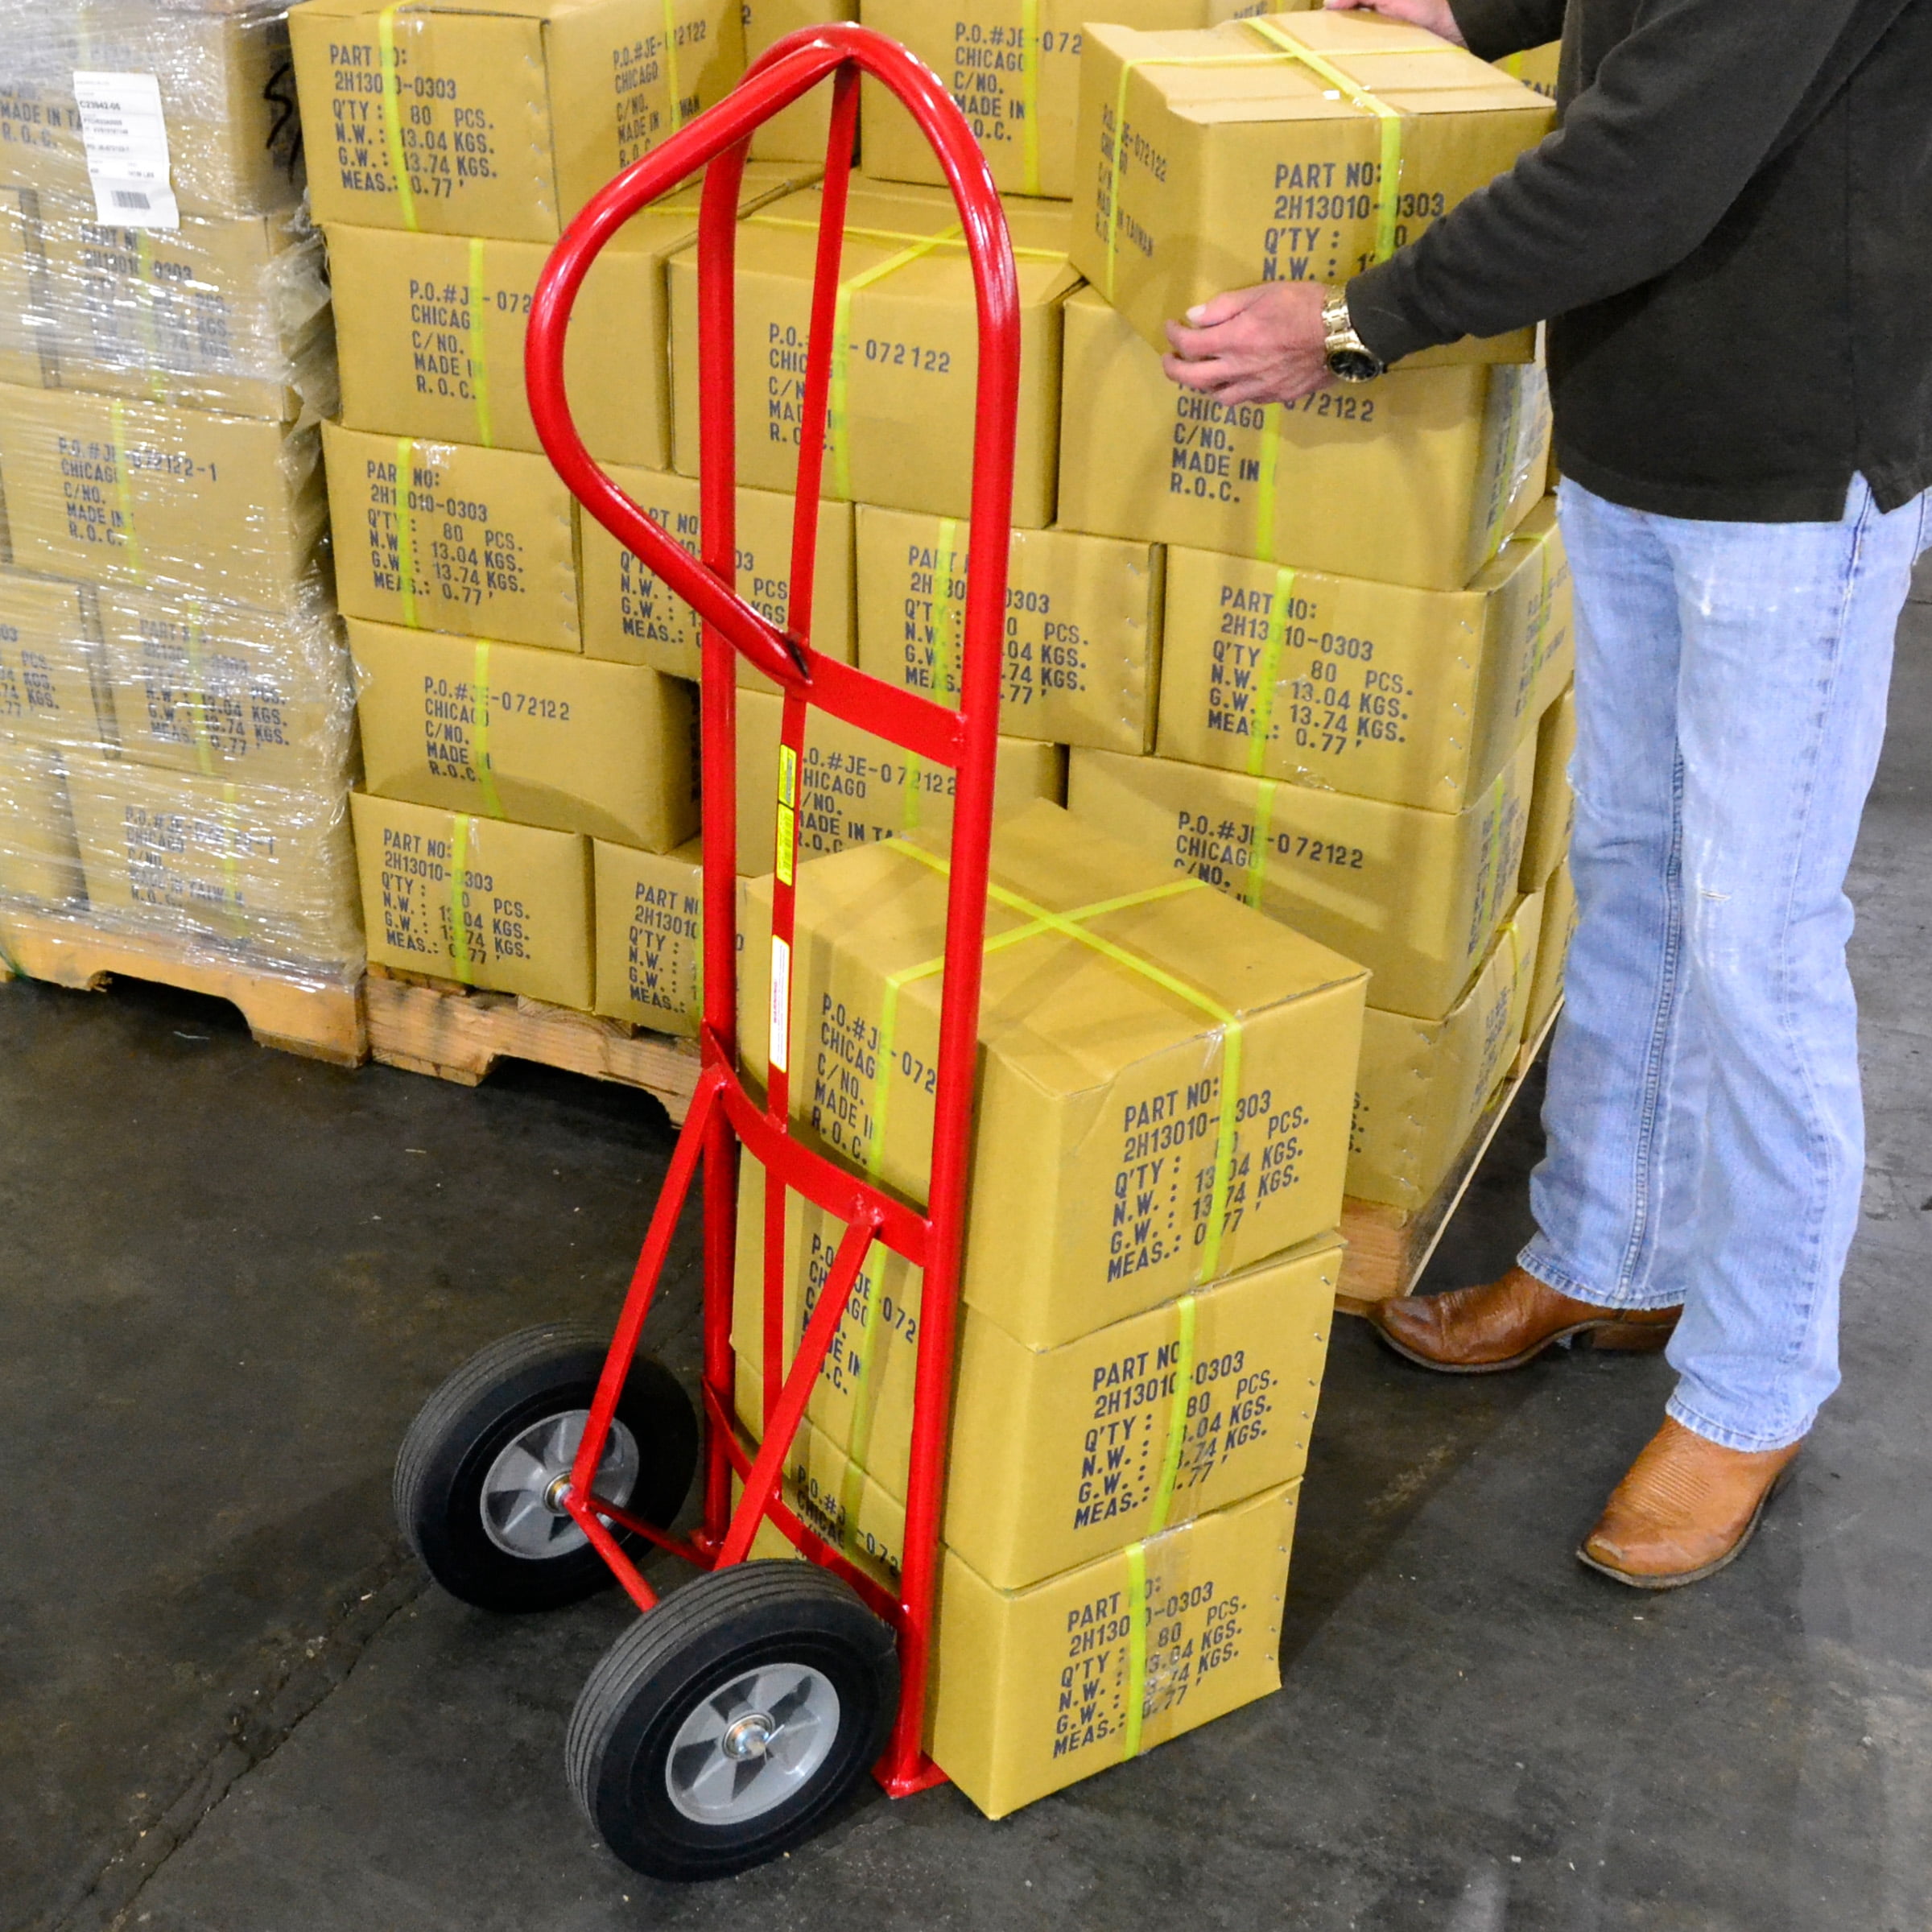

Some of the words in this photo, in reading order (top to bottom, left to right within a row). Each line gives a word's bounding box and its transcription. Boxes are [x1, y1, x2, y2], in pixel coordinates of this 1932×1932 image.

[330, 43, 372, 66] PART
[615, 61, 658, 93] CHICAGO
[955, 71, 1004, 94] C/NO.
[411, 105, 431, 126] 80
[454, 108, 494, 129] PCS.
[618, 114, 646, 144] MADE
[650, 111, 659, 131] IN
[454, 133, 494, 154] KGS.
[457, 156, 497, 179] KGS.
[1274, 163, 1336, 188] PART
[411, 304, 470, 330] CHICAG
[412, 331, 464, 354] C/NO.
[414, 353, 460, 376] MADE
[416, 375, 476, 399] R.O.C.
[1177, 395, 1265, 430] CHICAGO
[1174, 423, 1234, 452] C/NO.
[61, 458, 118, 483] CHICAG
[367, 460, 397, 483] PAR
[414, 468, 440, 488] NO:
[1172, 448, 1229, 477] MADE
[1240, 459, 1260, 481] IN
[64, 481, 105, 504] C/NO.
[371, 484, 487, 522] 2H1010-0303
[1170, 473, 1240, 503] R.O.C.
[67, 502, 106, 524] MADE
[111, 510, 124, 527] IN
[444, 523, 463, 543] 80
[485, 530, 522, 551] PCS.
[431, 542, 478, 566] 13.04
[485, 551, 522, 572] KGS.
[436, 562, 480, 585] 13.74
[487, 572, 525, 593] KGS.
[753, 578, 787, 601] PCS
[1220, 585, 1274, 614] PART
[905, 599, 932, 621] Q'T
[1044, 621, 1088, 646] PCS.
[1220, 613, 1374, 662] 2H1310-0303
[1041, 646, 1086, 668] KGS.
[1041, 667, 1085, 691] KGS.
[1311, 660, 1336, 683] 80
[1365, 669, 1413, 696] PCS.
[425, 676, 570, 720] P.O.#-072122
[1291, 682, 1350, 711] 13.04
[1360, 693, 1408, 720] KGS.
[254, 724, 289, 745] KGS.
[426, 720, 469, 745] C/NO.
[1290, 704, 1348, 734] 13.74
[1357, 716, 1406, 743] KGS.
[427, 741, 469, 765] MADE
[803, 768, 866, 799] HICAGO
[803, 791, 843, 816] /NO.
[799, 810, 840, 836] ADE
[848, 822, 865, 841] IN
[1179, 811, 1364, 869] P.O.#J-072122
[383, 828, 421, 854] PART
[427, 839, 452, 859] NO:
[385, 851, 493, 892] 2H13010-303
[494, 898, 530, 919] PCS.
[636, 882, 678, 910] PART
[493, 919, 530, 941] KGS.
[495, 937, 530, 960] KGS.
[821, 1022, 875, 1080] CHICAG
[818, 1053, 865, 1106] C/NO.
[815, 1079, 857, 1128] MADE
[1124, 1091, 1179, 1133] PART
[1187, 1077, 1219, 1110] NO:
[812, 1106, 867, 1165] R.O.C.
[1124, 1089, 1271, 1163] 2H13010-303
[1268, 1105, 1310, 1139] PCS.
[1261, 1137, 1302, 1170] KGS.
[1257, 1164, 1299, 1198] KGS.
[1092, 1352, 1149, 1392] PART
[1236, 1369, 1278, 1399] PCS.
[1229, 1395, 1272, 1426] KGS.
[1224, 1420, 1267, 1451] KGS.
[1067, 1591, 1121, 1633] PART
[1207, 1596, 1246, 1627] PCS.
[1201, 1620, 1242, 1652] KGS.
[1197, 1642, 1238, 1675] KGS.
